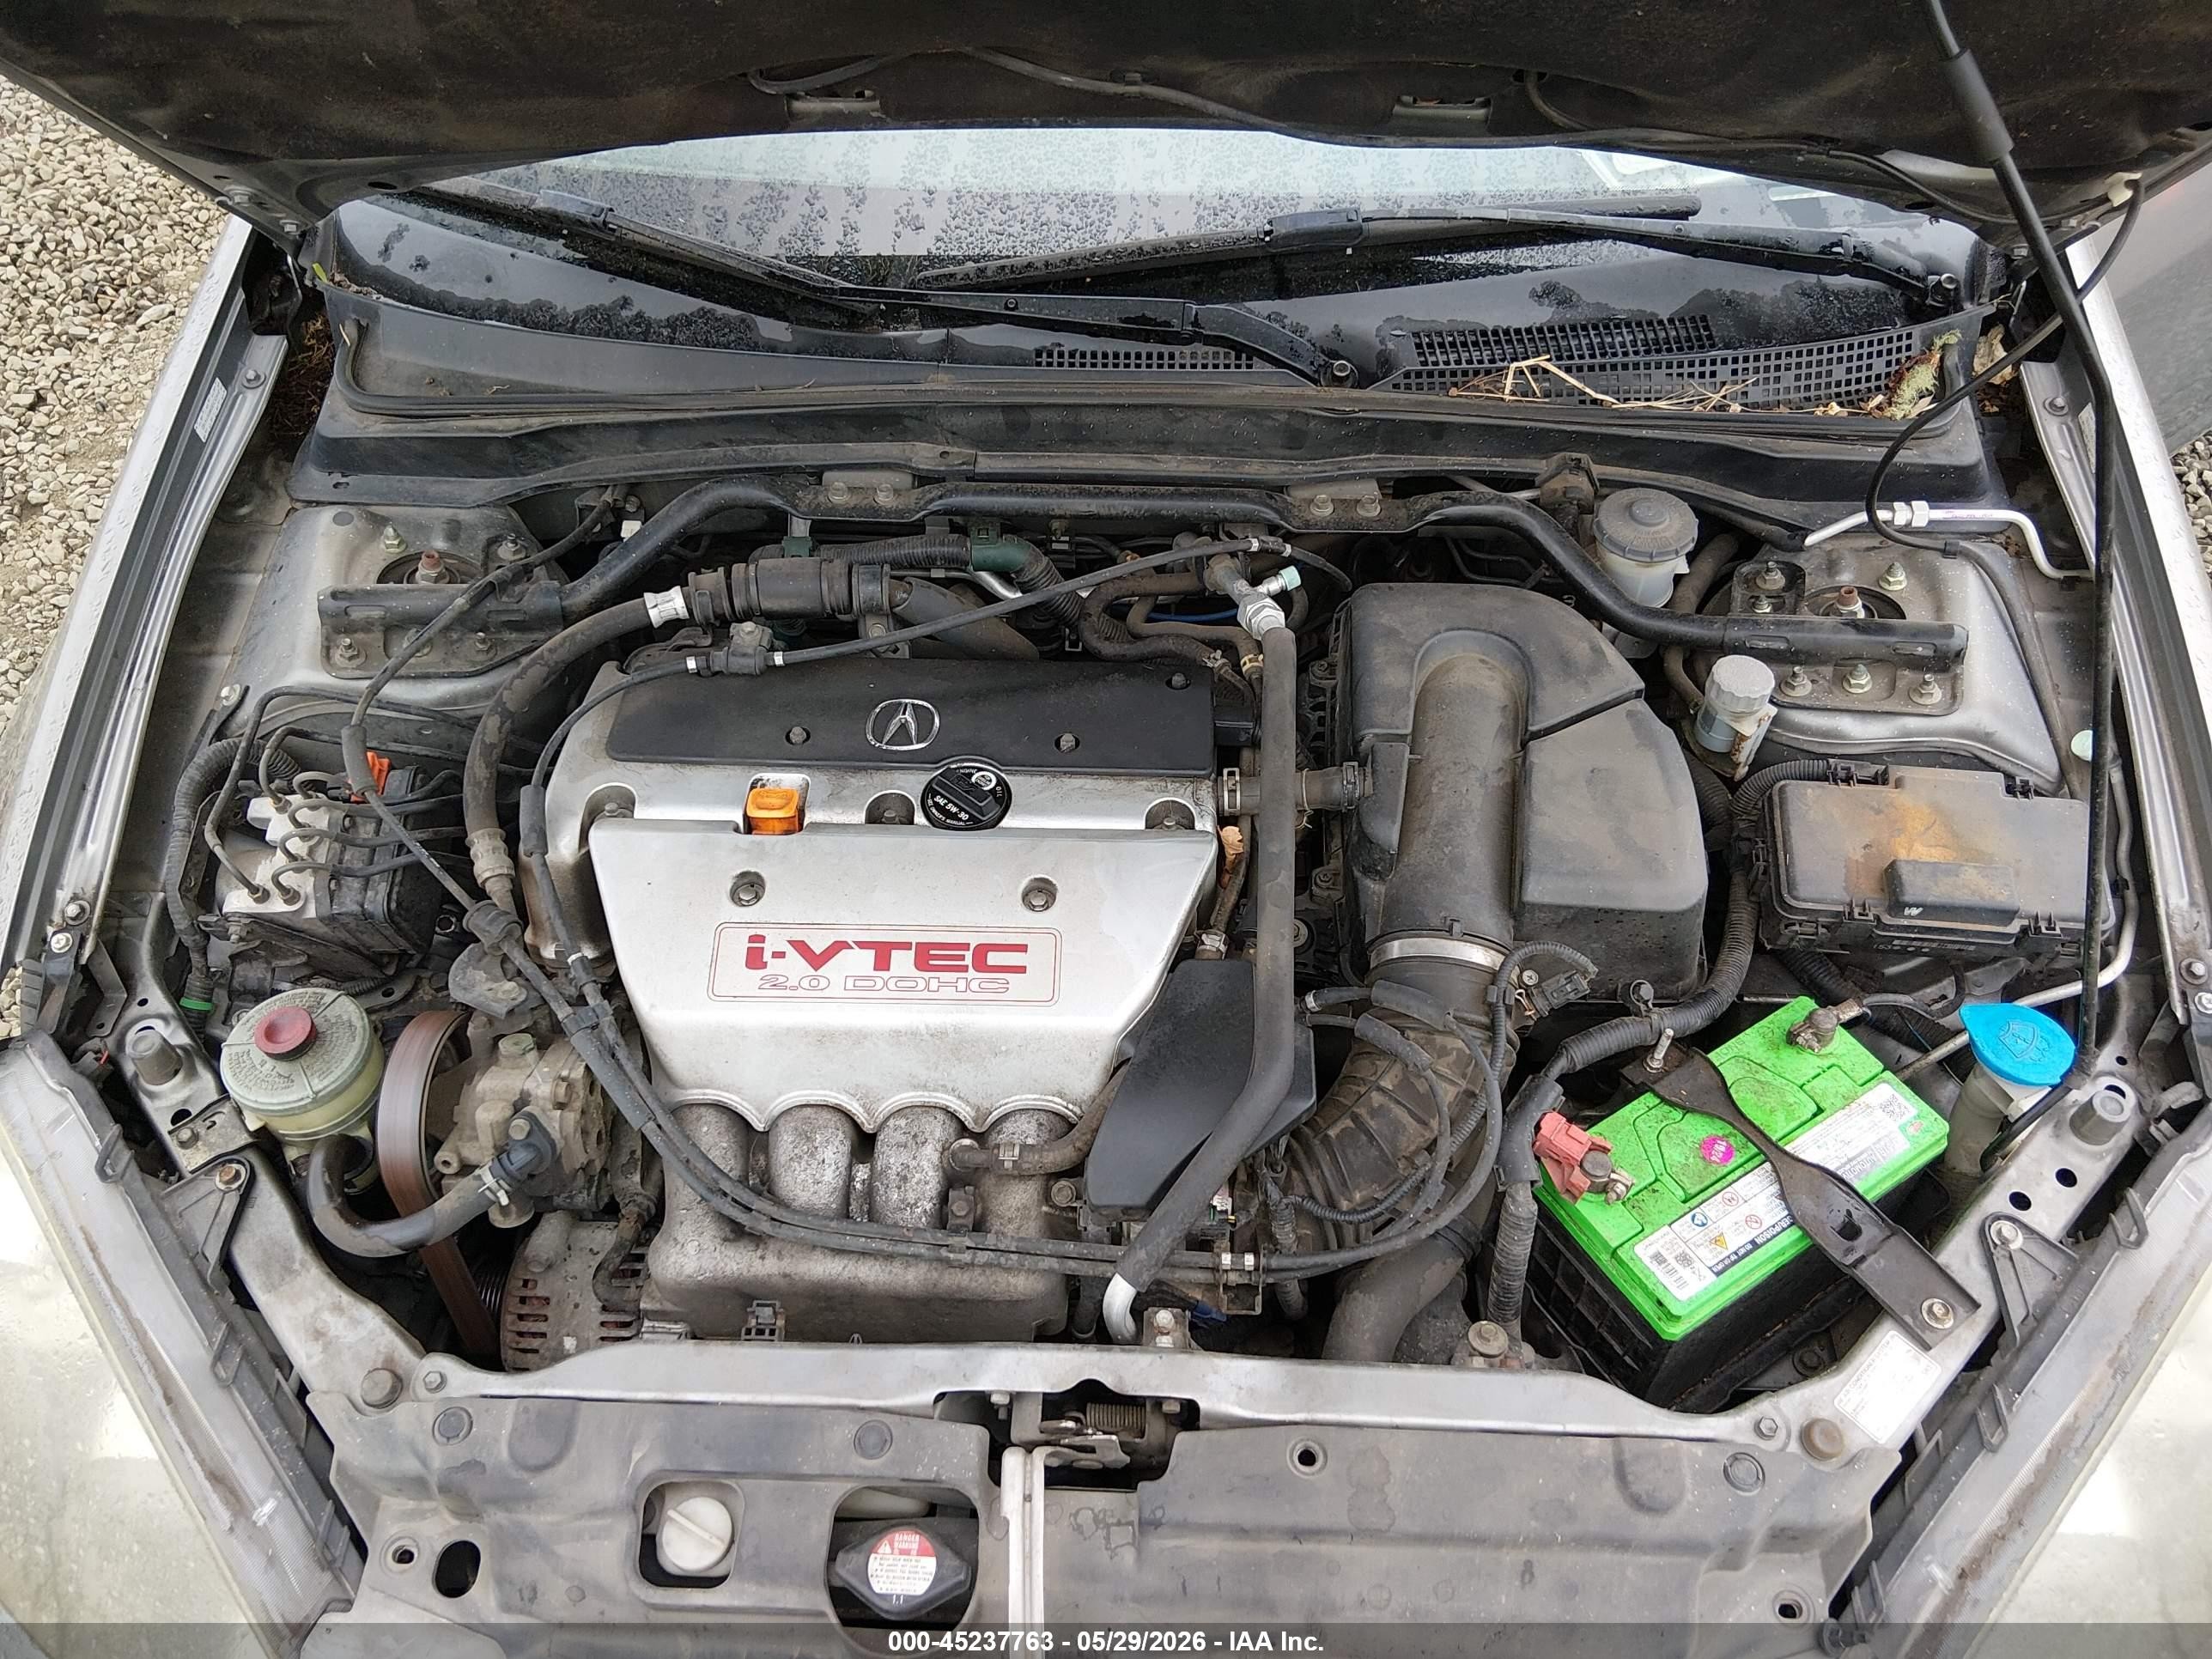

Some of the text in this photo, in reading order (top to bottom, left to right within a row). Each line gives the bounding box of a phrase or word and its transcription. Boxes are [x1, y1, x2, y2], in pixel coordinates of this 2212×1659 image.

[934, 795, 969, 821] SAE 5W-30
[744, 933, 1029, 974] i-VTEC
[757, 974, 1010, 994] 2.0 DOHC
[1843, 1154, 1876, 1180] AUTOMOTIV
[1736, 1247, 1747, 1256] NOT
[893, 1595, 903, 1605] 1.1
